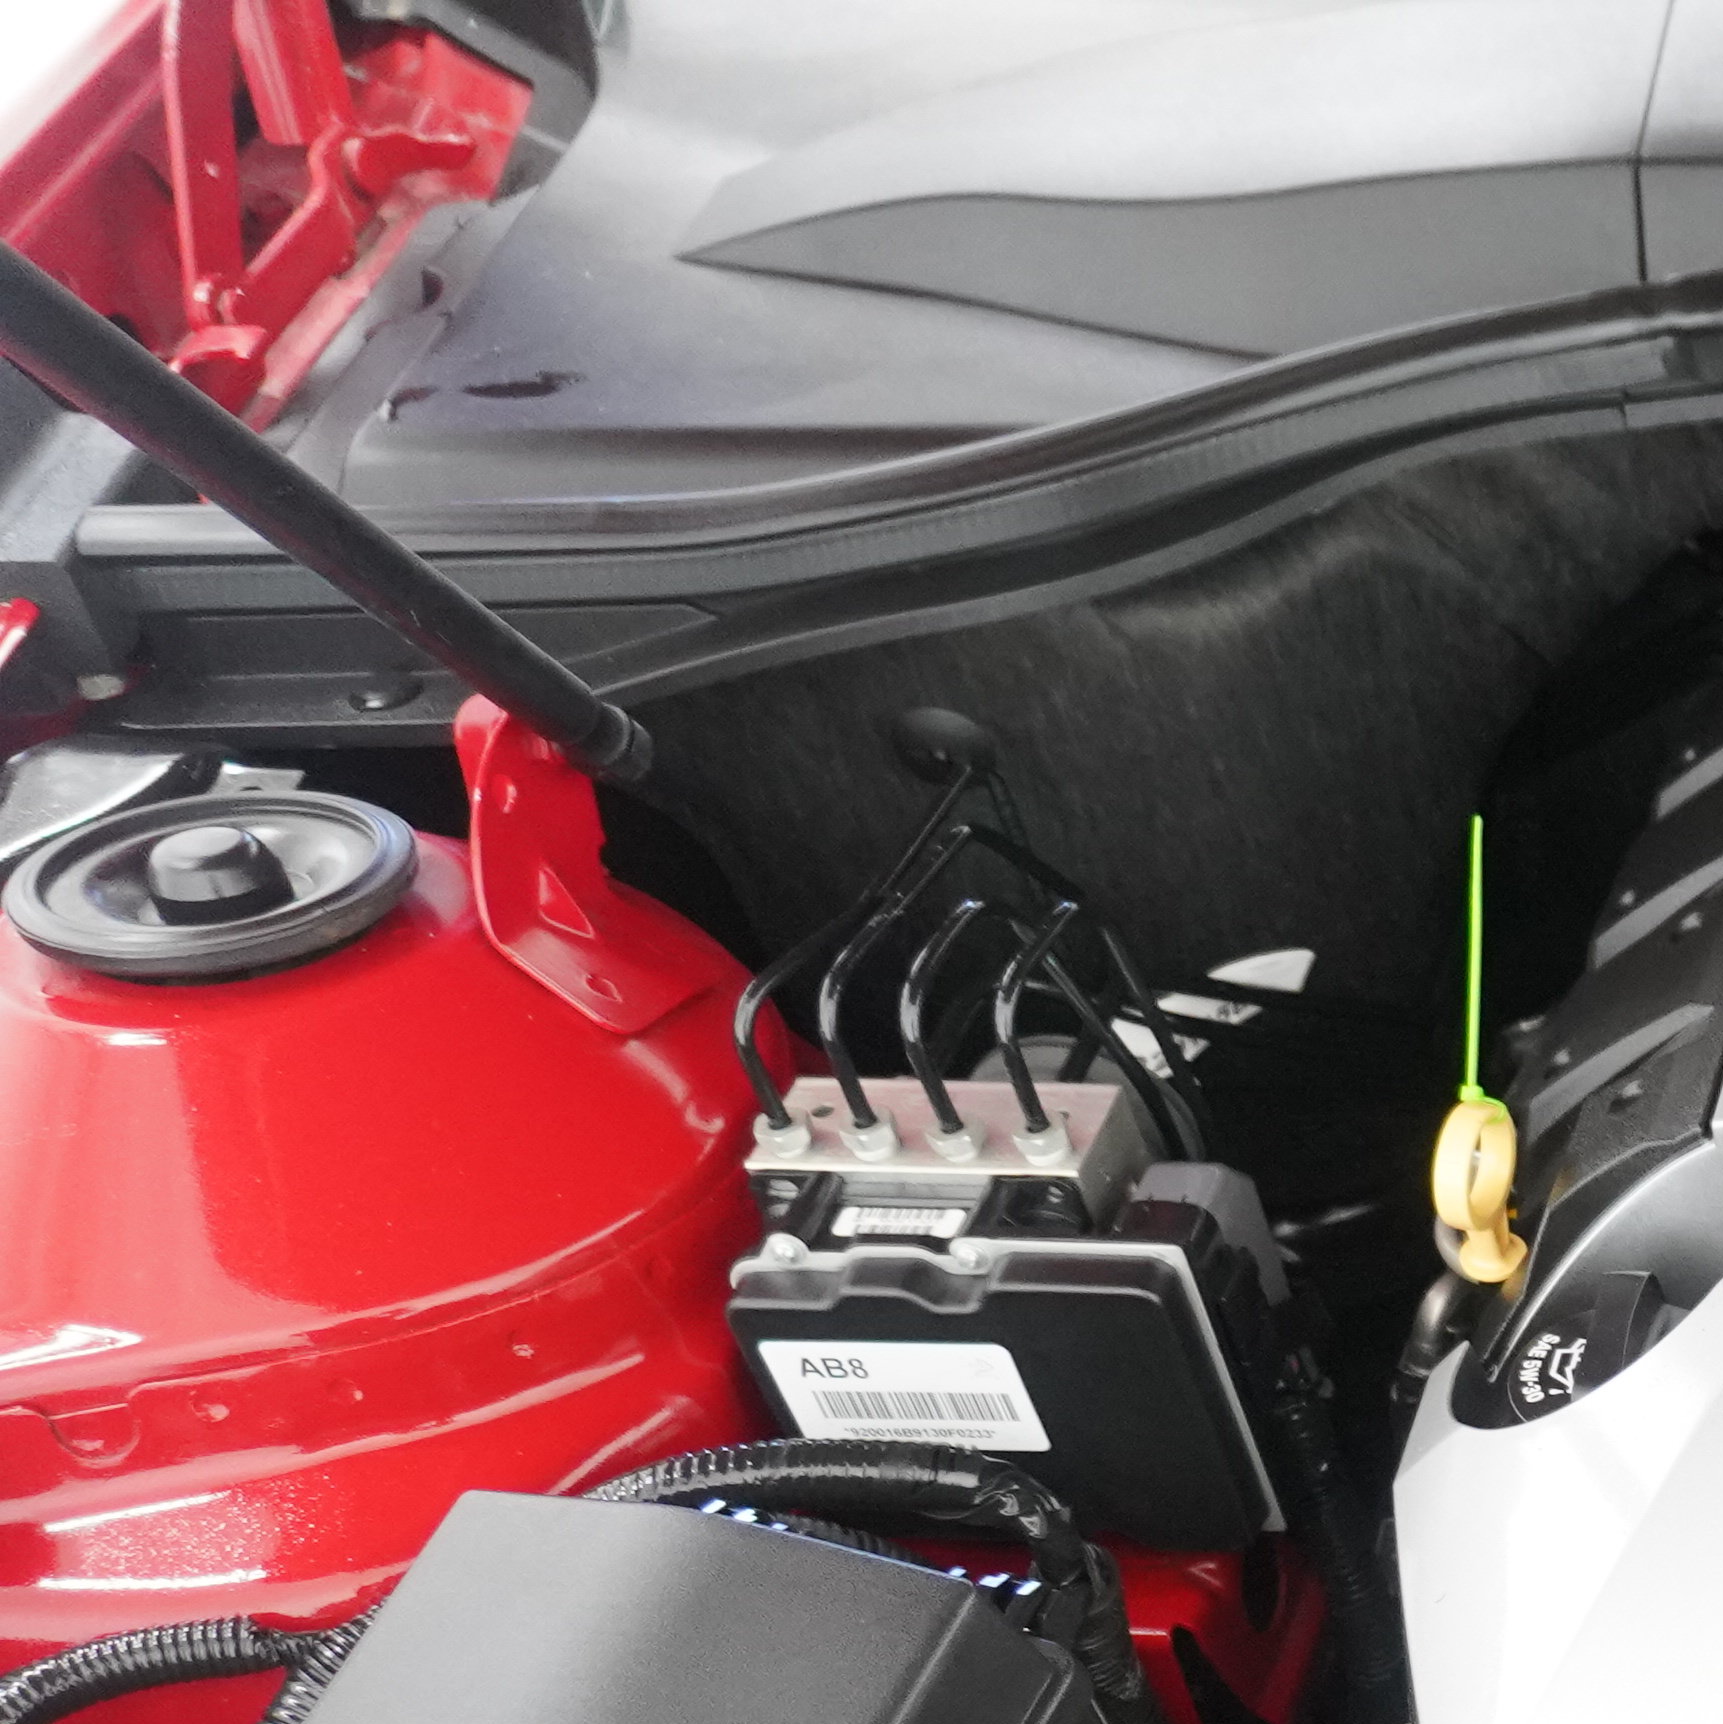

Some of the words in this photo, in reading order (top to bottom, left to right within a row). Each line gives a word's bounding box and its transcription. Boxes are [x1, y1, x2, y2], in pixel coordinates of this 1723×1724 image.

[1527, 1333, 1561, 1359] SAE
[800, 1357, 869, 1380] AB8
[1519, 1359, 1546, 1403] 5W-30
